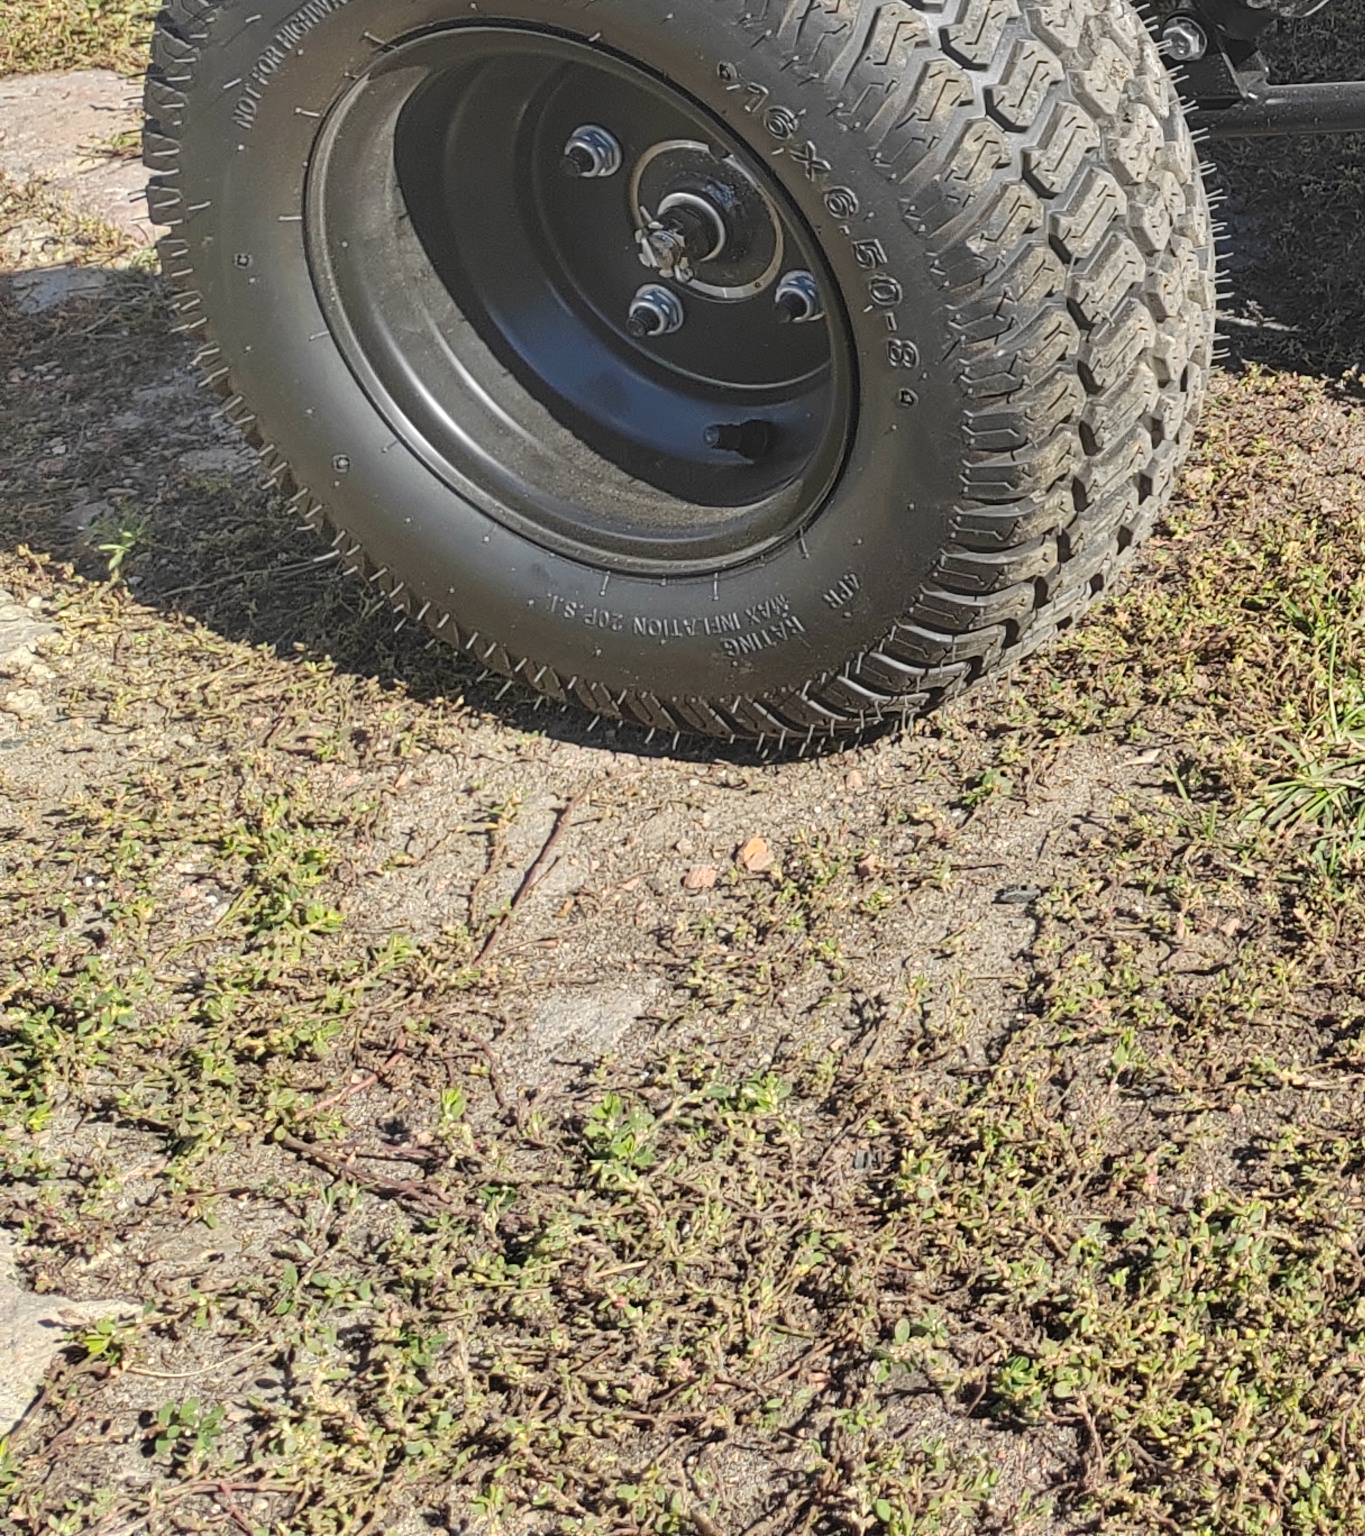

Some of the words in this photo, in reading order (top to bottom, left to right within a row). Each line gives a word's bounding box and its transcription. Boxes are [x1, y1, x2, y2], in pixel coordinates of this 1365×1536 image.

[231, 82, 262, 129] NOT
[252, 45, 286, 85] FOR
[633, 612, 742, 638] INFLATION
[748, 593, 791, 625] MAX
[720, 616, 806, 656] RATING
